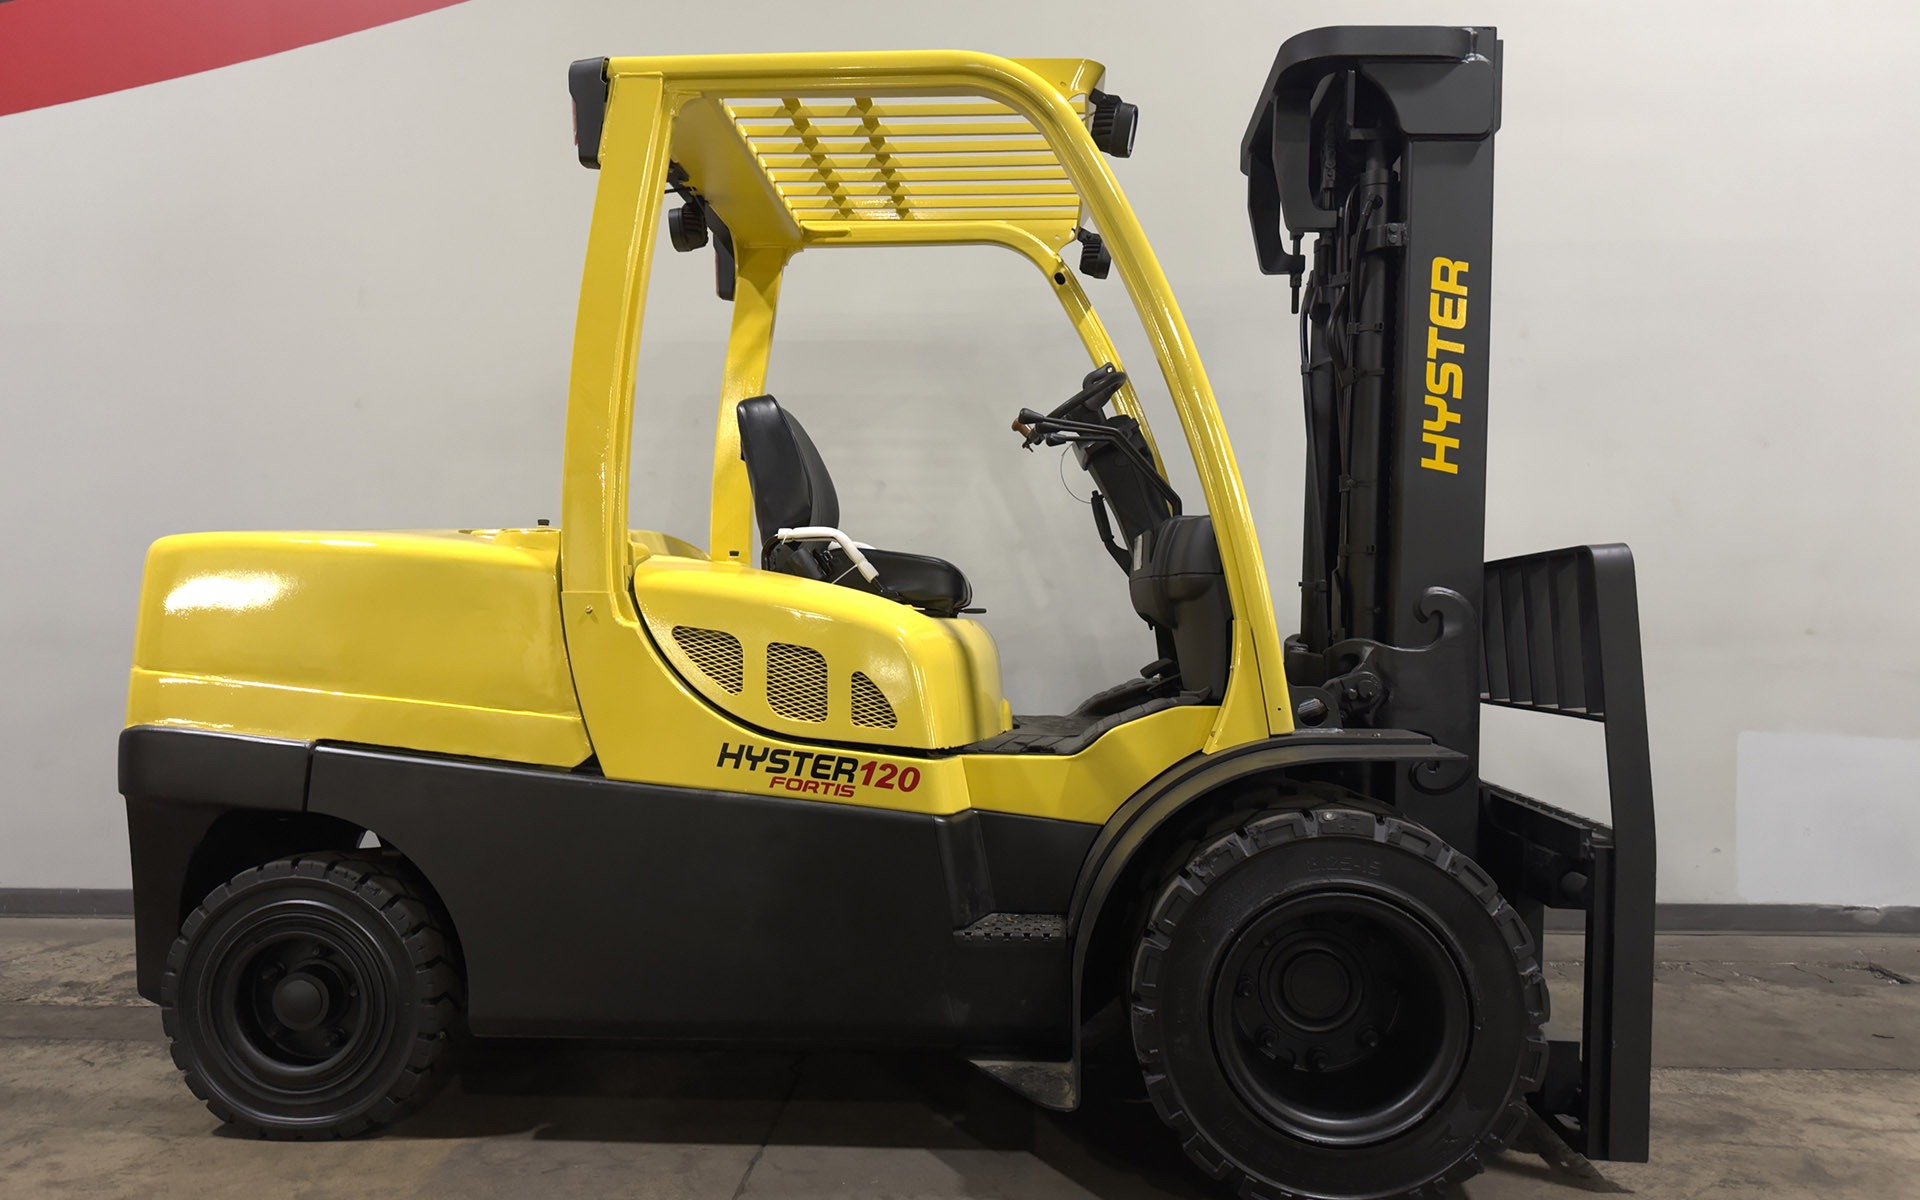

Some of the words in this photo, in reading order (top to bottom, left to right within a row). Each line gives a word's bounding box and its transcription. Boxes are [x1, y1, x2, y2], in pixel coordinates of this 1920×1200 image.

[1420, 256, 1469, 475] HYSTER
[716, 742, 859, 783] HYSTER
[860, 761, 921, 792] 120
[769, 777, 856, 797] FORTIS
